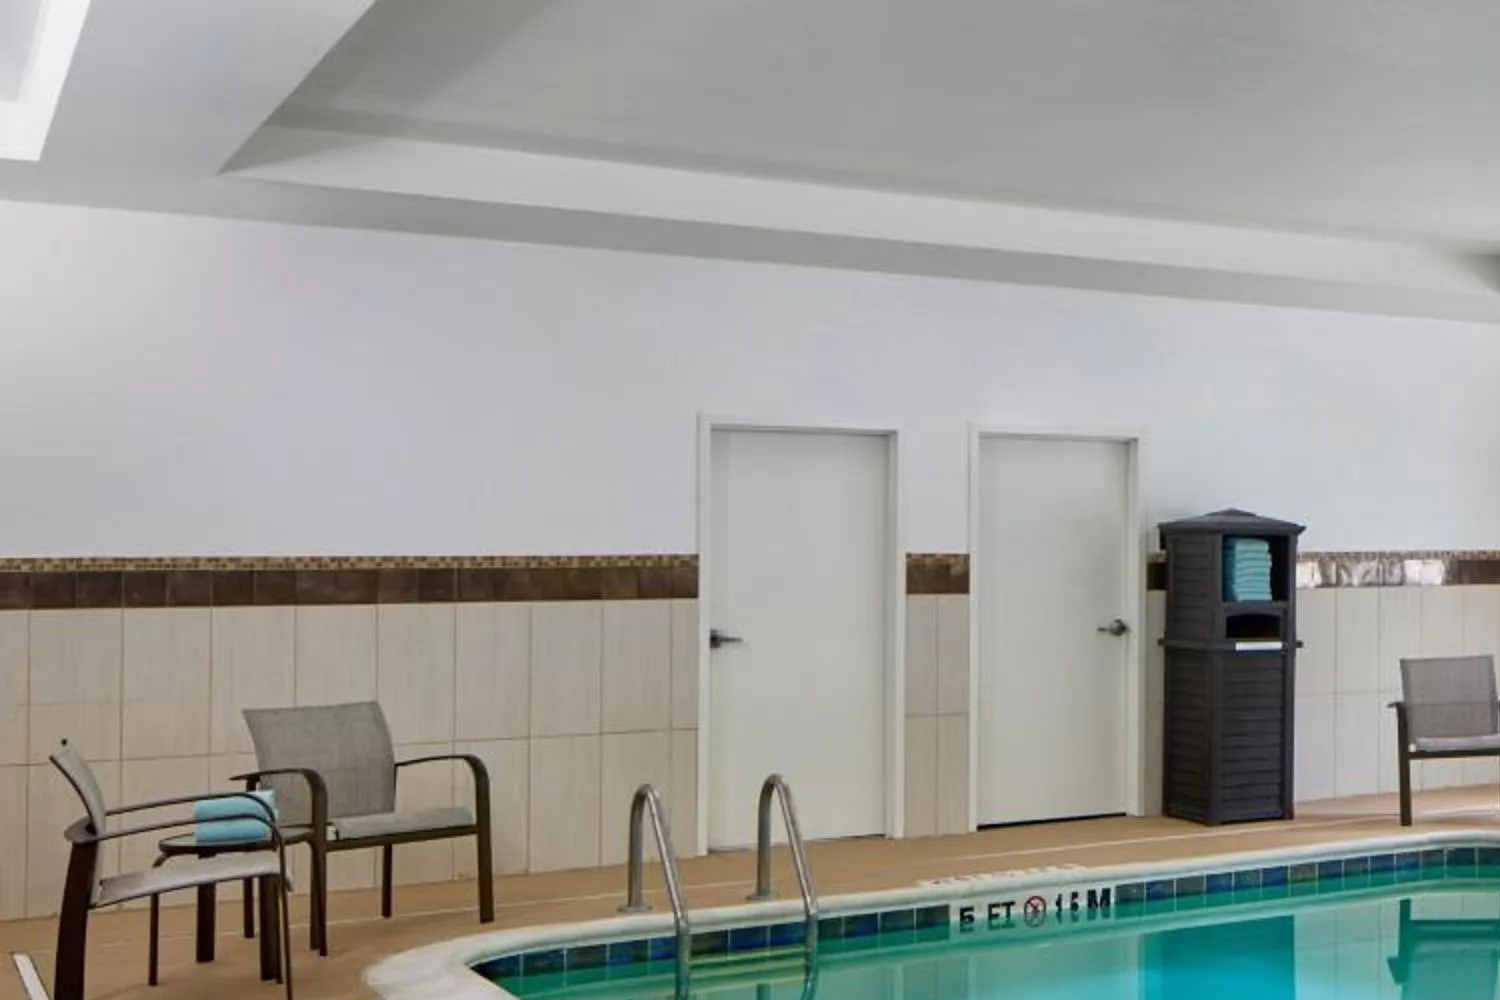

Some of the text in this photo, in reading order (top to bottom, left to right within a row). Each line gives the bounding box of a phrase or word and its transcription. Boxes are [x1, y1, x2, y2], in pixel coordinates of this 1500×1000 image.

[959, 906, 975, 924] 5
[987, 900, 1016, 921] FT
[1087, 887, 1111, 909] M
